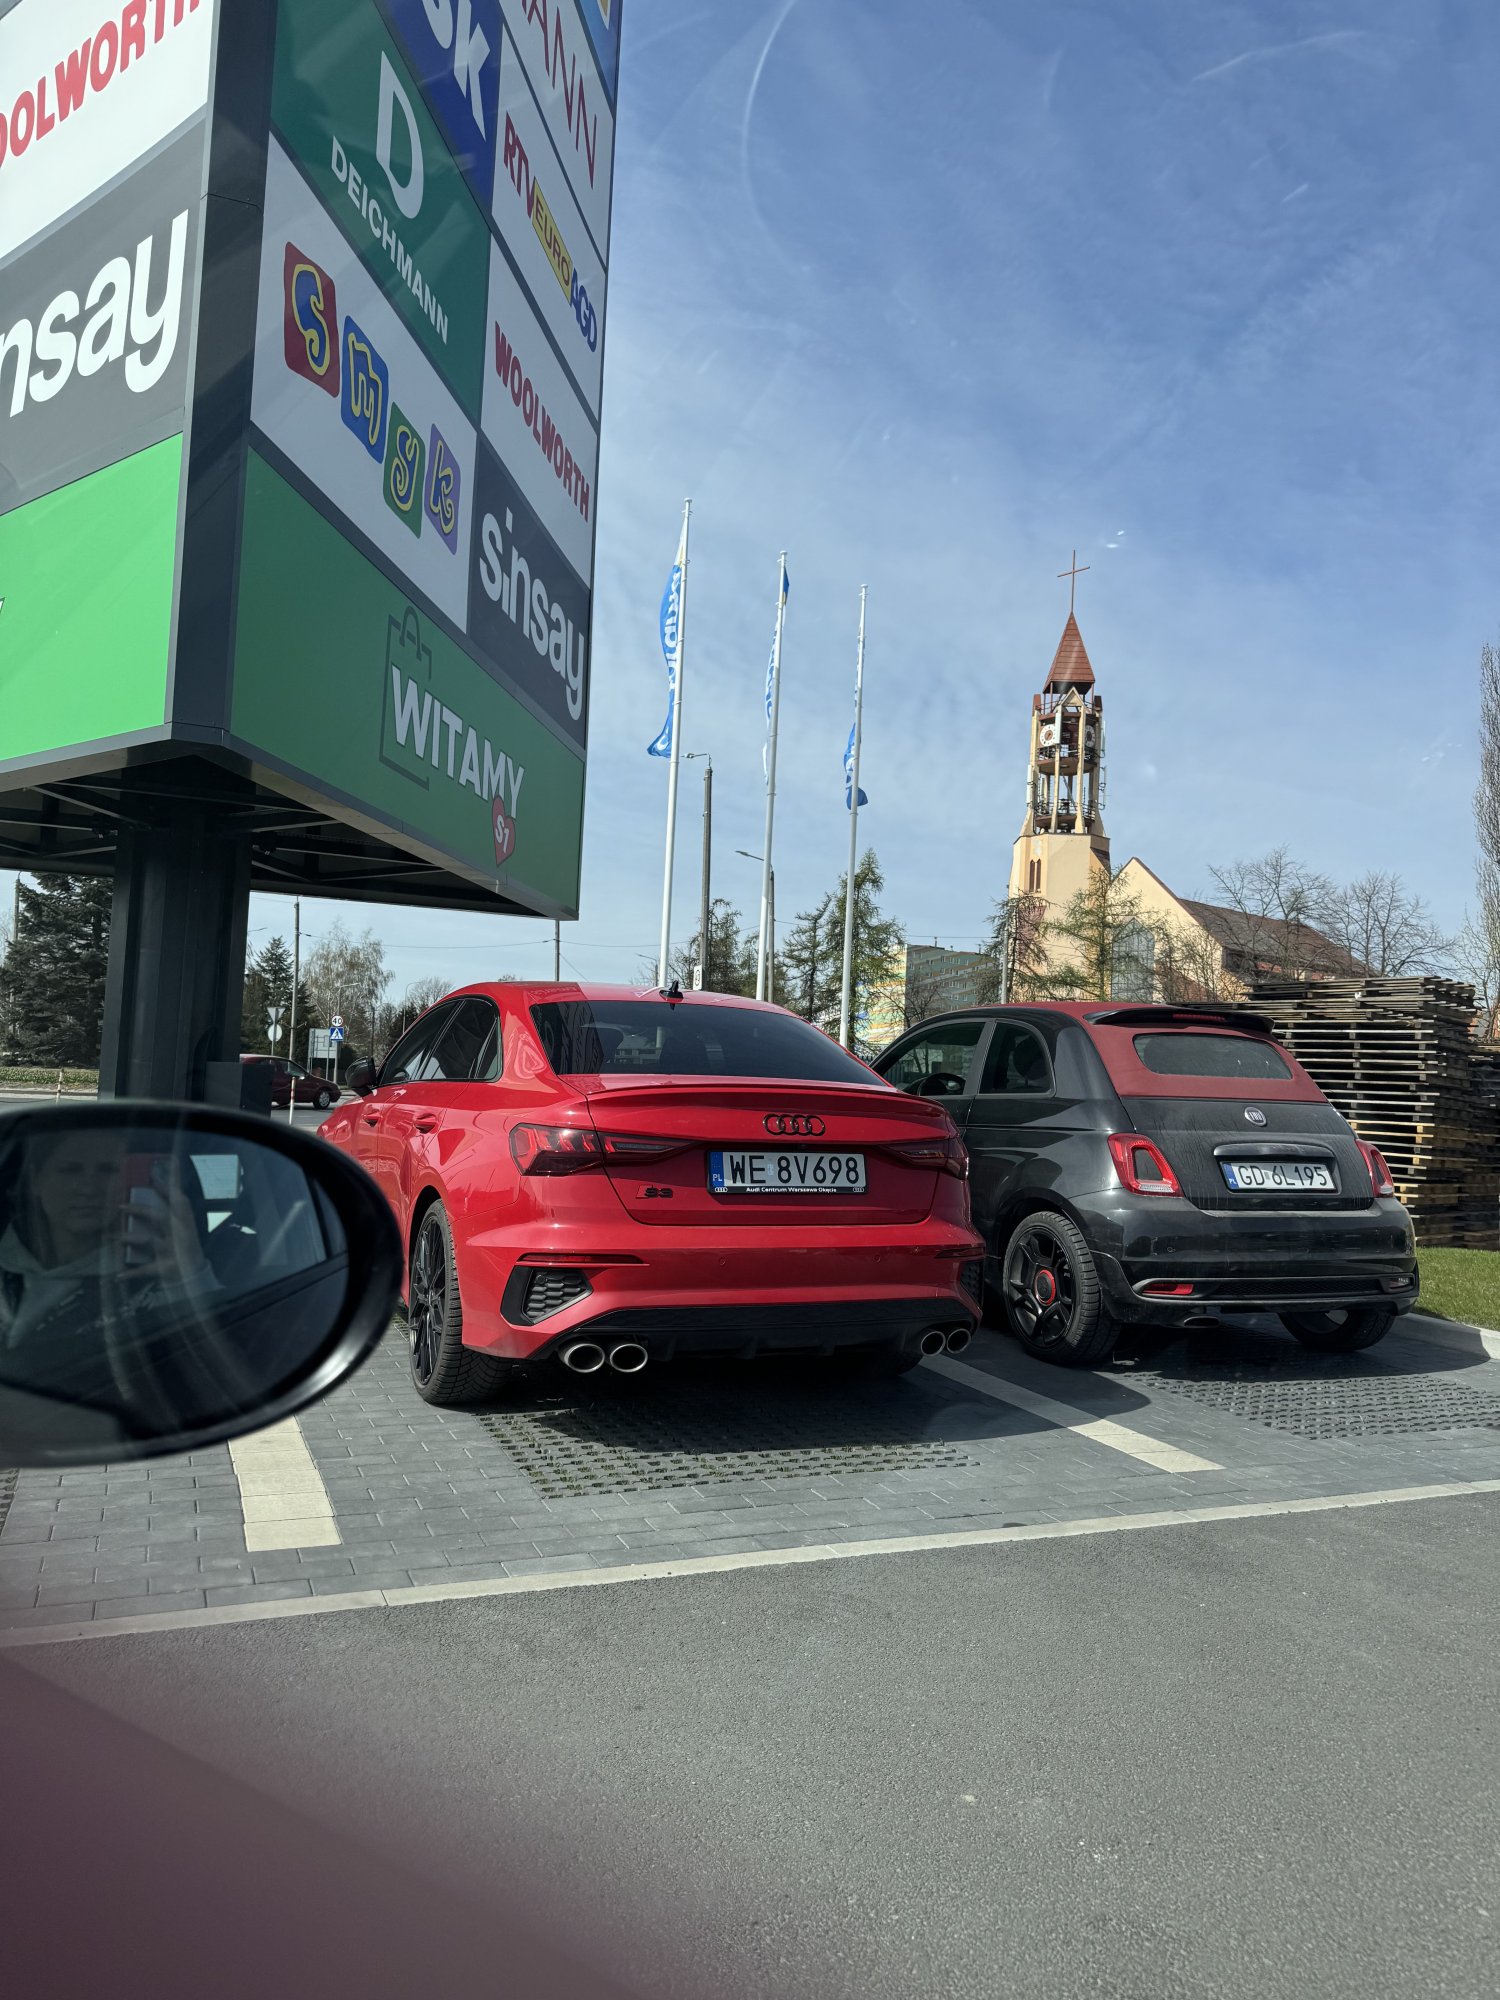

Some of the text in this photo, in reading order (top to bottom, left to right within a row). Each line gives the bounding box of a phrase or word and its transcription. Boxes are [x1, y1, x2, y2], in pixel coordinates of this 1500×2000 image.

[376, 50, 424, 219] D
[521, 0, 598, 190] ANN
[331, 136, 449, 344] DEICHMANN
[504, 111, 598, 352] RTV EURO AGD
[495, 321, 590, 523] WOOLWORTH
[479, 506, 585, 721] sinsay
[391, 664, 525, 820] WITAMY
[332, 1017, 343, 1025] 40
[712, 1173, 723, 1182] PL
[730, 1155, 860, 1185] WE 8V698
[1238, 1165, 1328, 1186] GD 6L195
